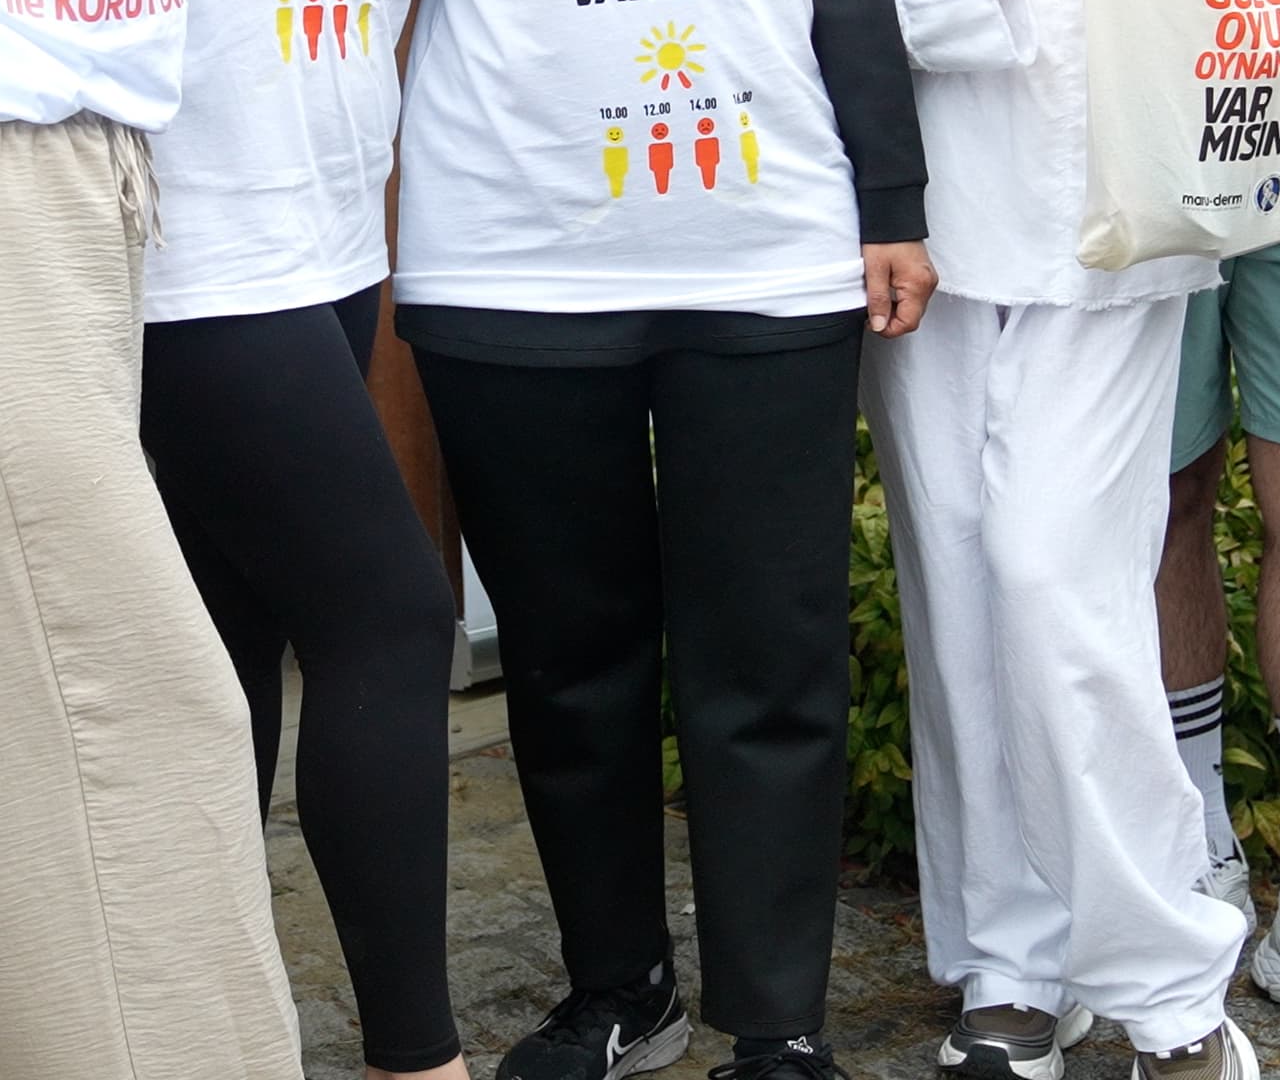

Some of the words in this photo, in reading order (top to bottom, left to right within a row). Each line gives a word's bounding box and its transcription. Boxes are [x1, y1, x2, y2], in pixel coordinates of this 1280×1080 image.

[599, 106, 628, 120] 10.00
[643, 102, 671, 116] 12.00
[689, 97, 717, 111] 14.00
[1205, 86, 1273, 123] VAR
